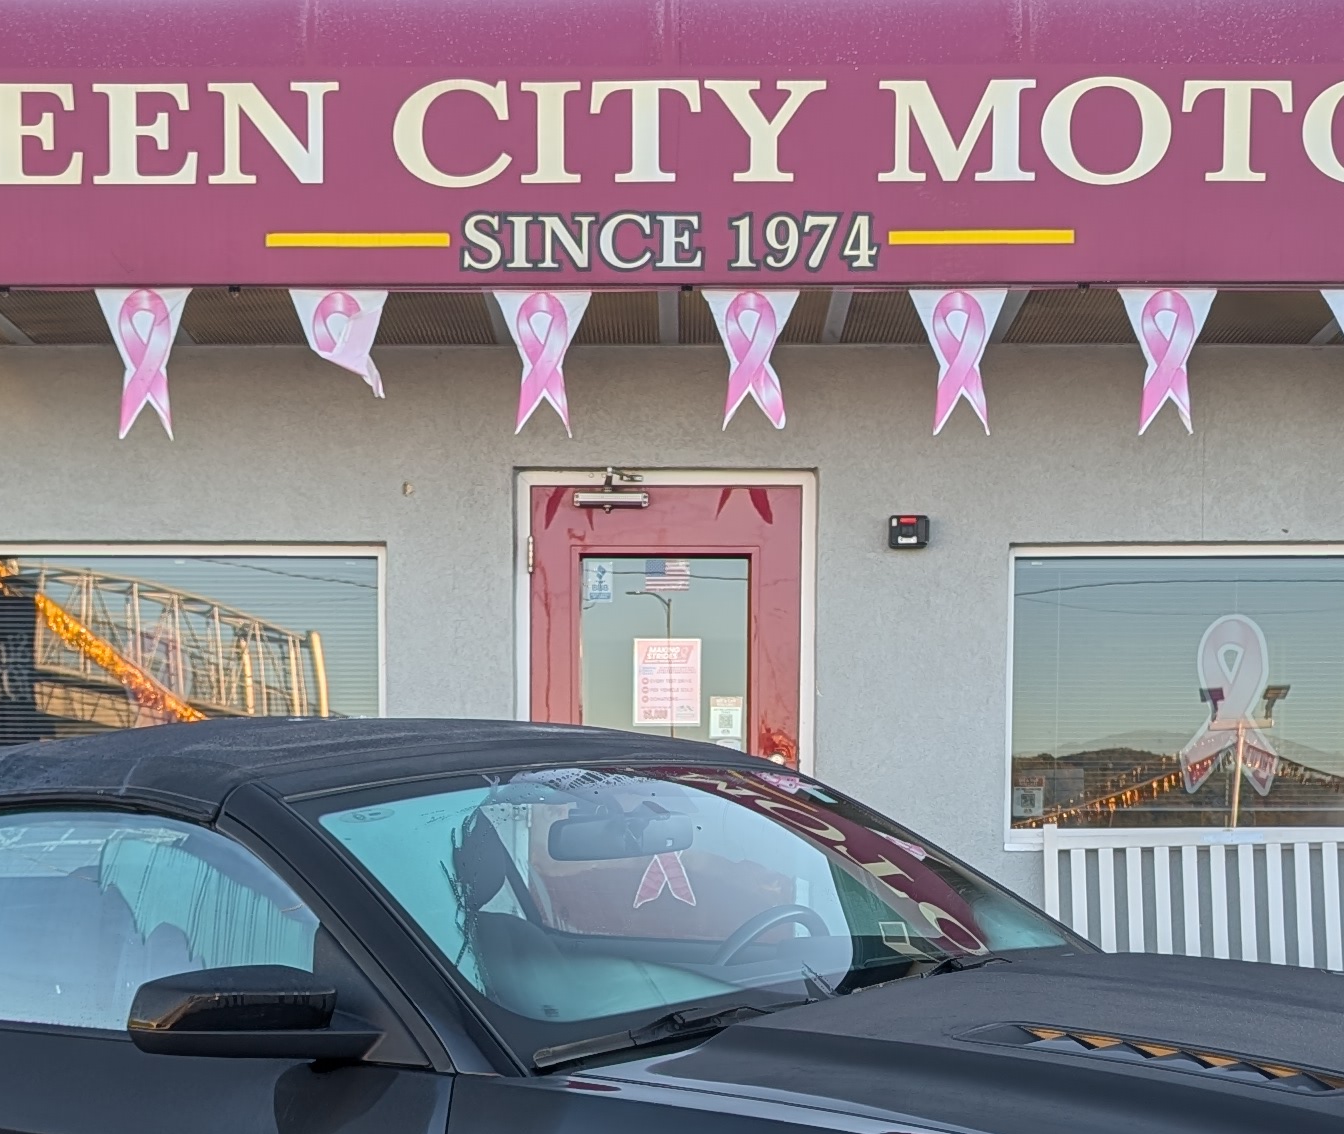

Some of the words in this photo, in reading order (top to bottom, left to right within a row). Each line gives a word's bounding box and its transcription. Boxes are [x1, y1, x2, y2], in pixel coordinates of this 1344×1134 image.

[392, 79, 827, 189] CITY
[461, 212, 705, 270] SINCE
[728, 213, 879, 270] 1974
